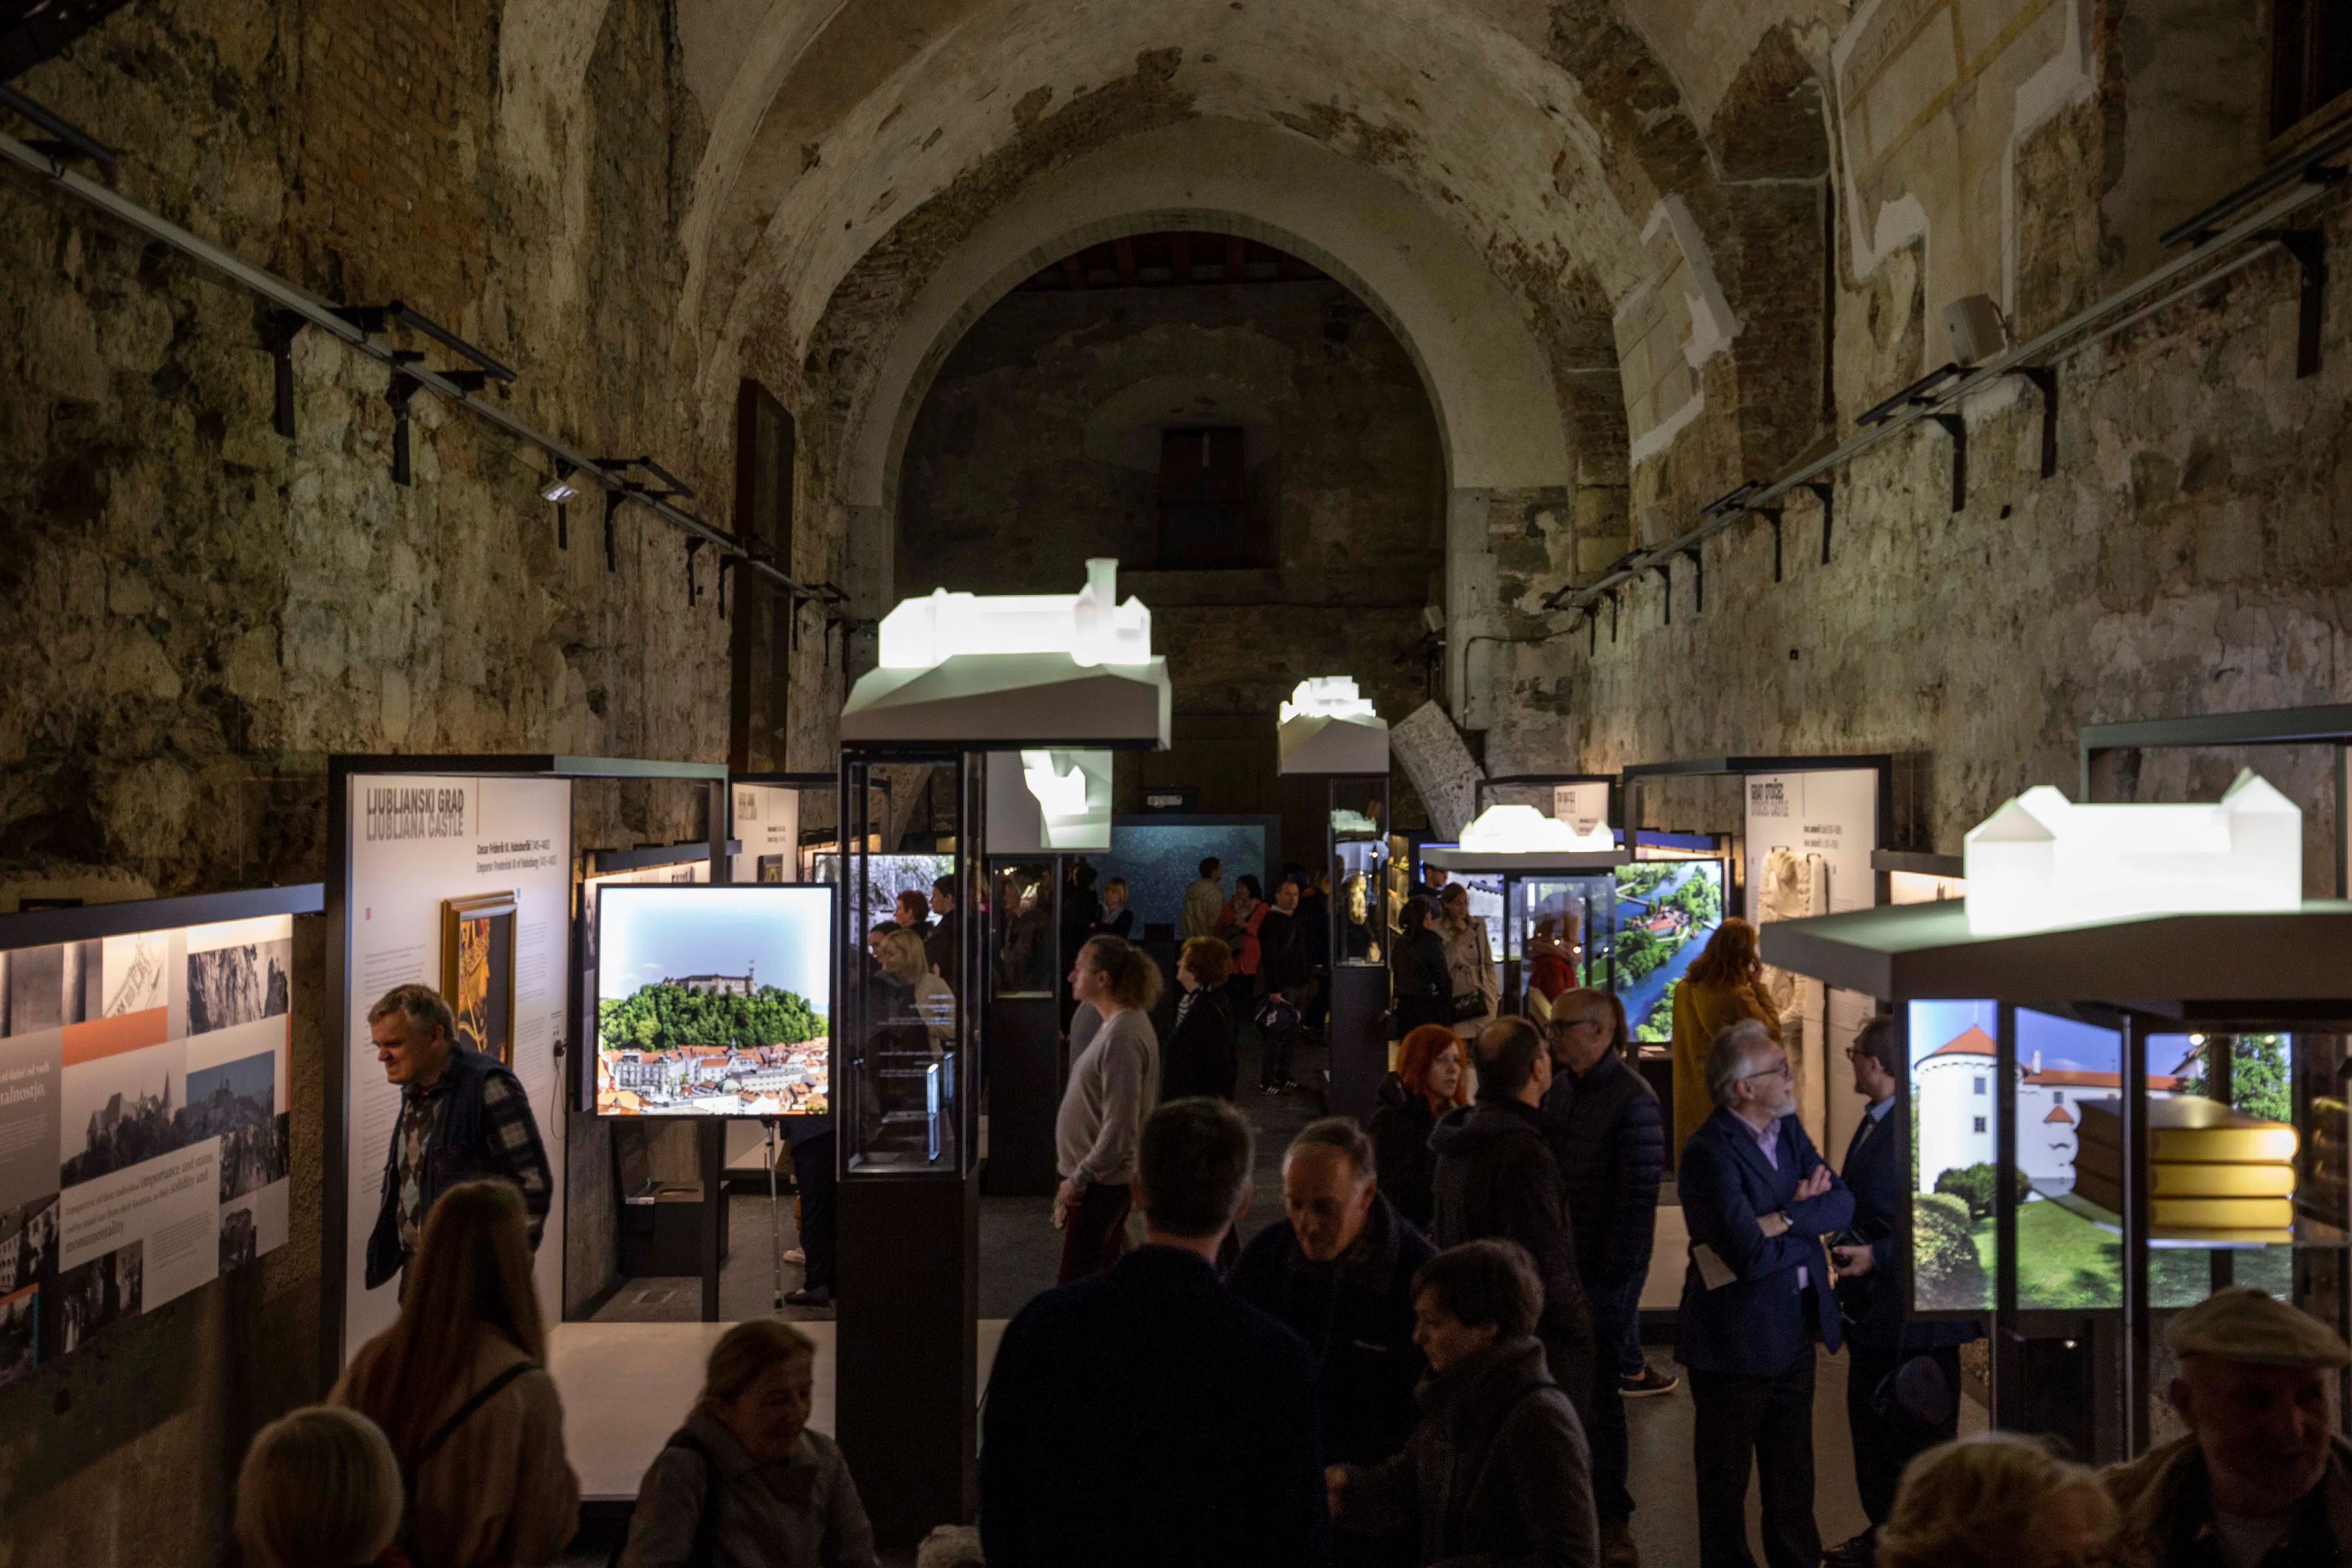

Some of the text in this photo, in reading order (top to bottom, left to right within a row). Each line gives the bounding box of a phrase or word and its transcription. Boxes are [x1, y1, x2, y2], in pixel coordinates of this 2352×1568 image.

[367, 788, 464, 815] LJUBLJANSKI GRAD
[366, 812, 464, 841] LJUBLJANA CASTLE
